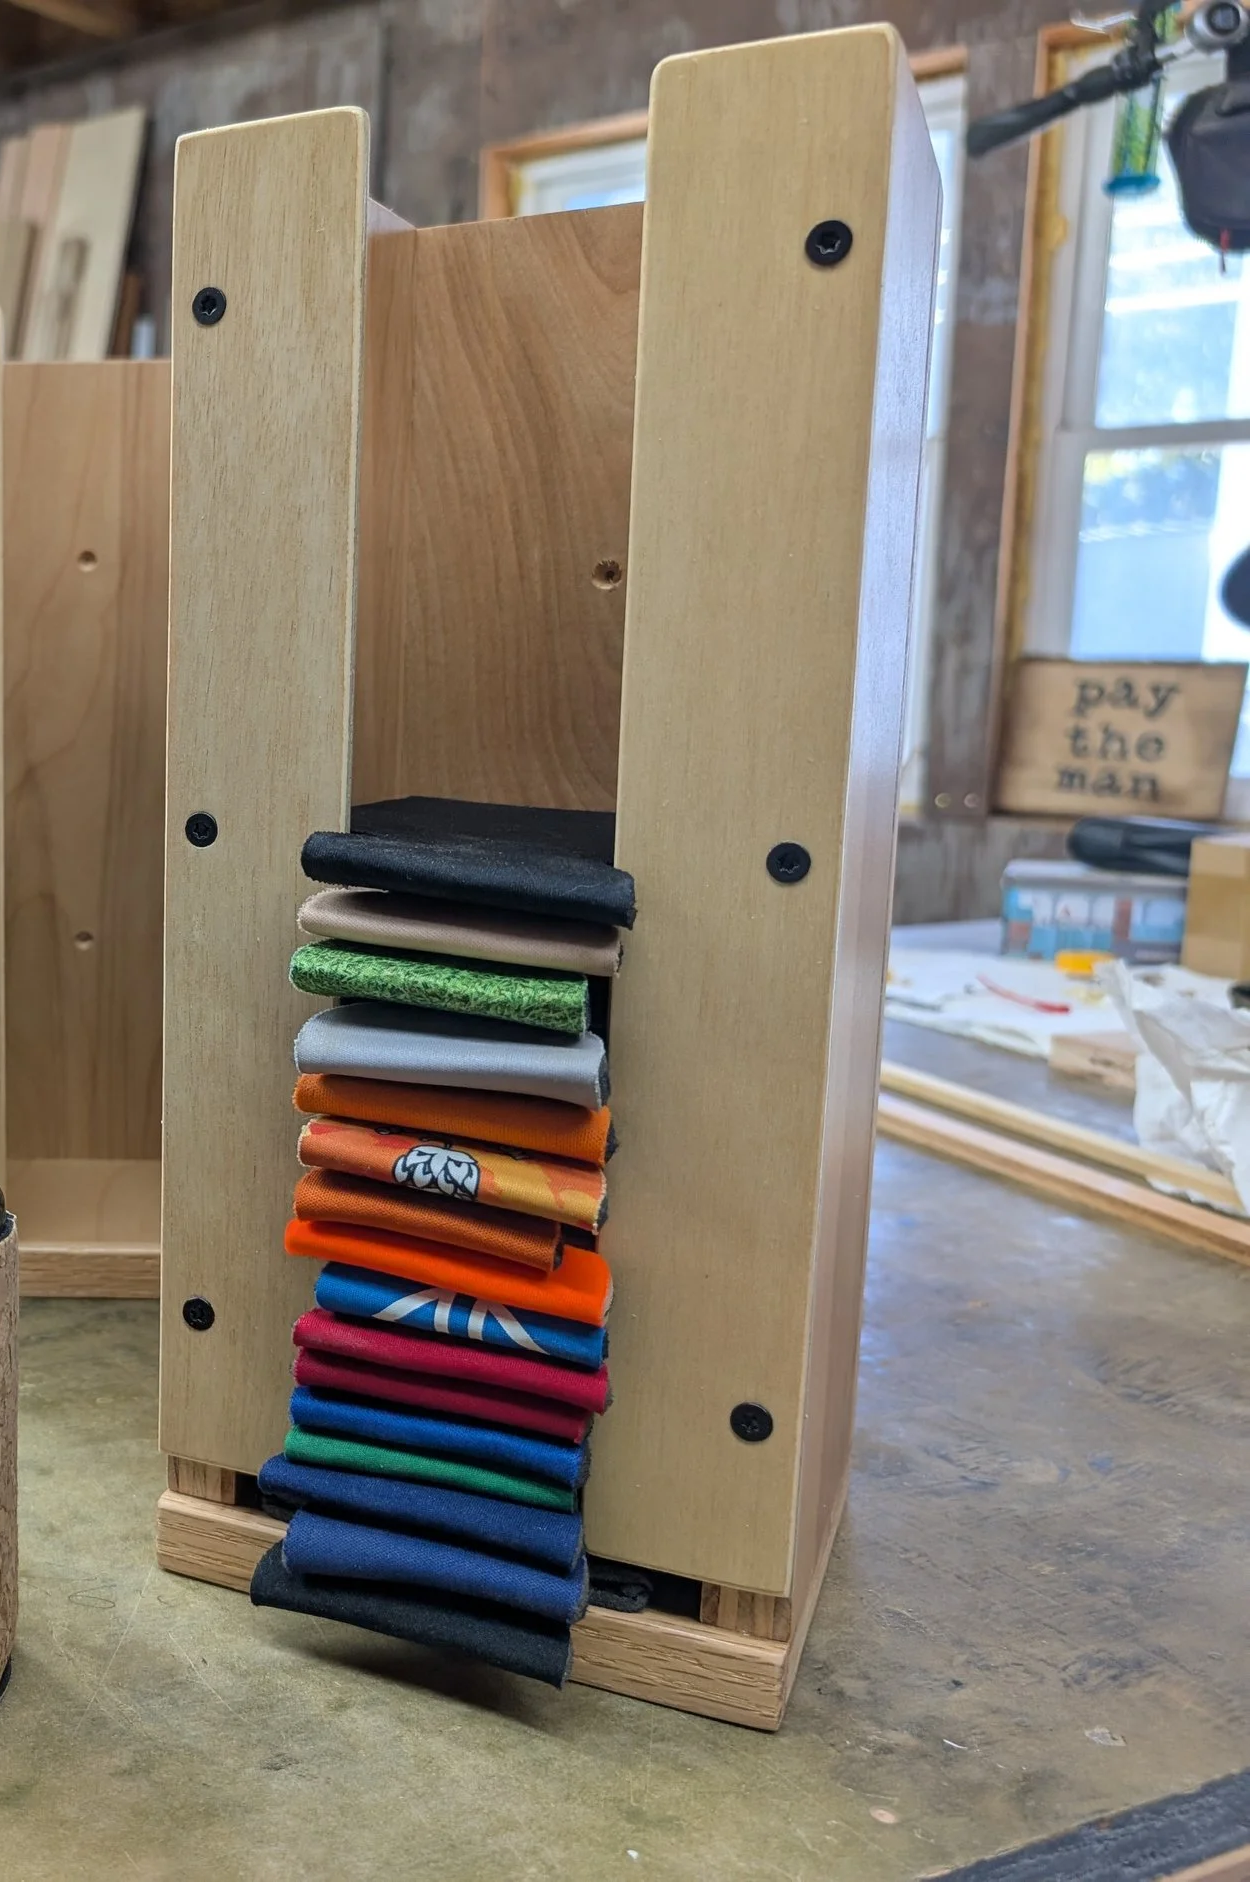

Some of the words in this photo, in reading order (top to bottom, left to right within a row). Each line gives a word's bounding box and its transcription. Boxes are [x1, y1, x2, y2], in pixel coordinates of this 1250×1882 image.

[1074, 678, 1179, 720] pay
[1067, 723, 1165, 762] the
[1057, 766, 1161, 803] man
